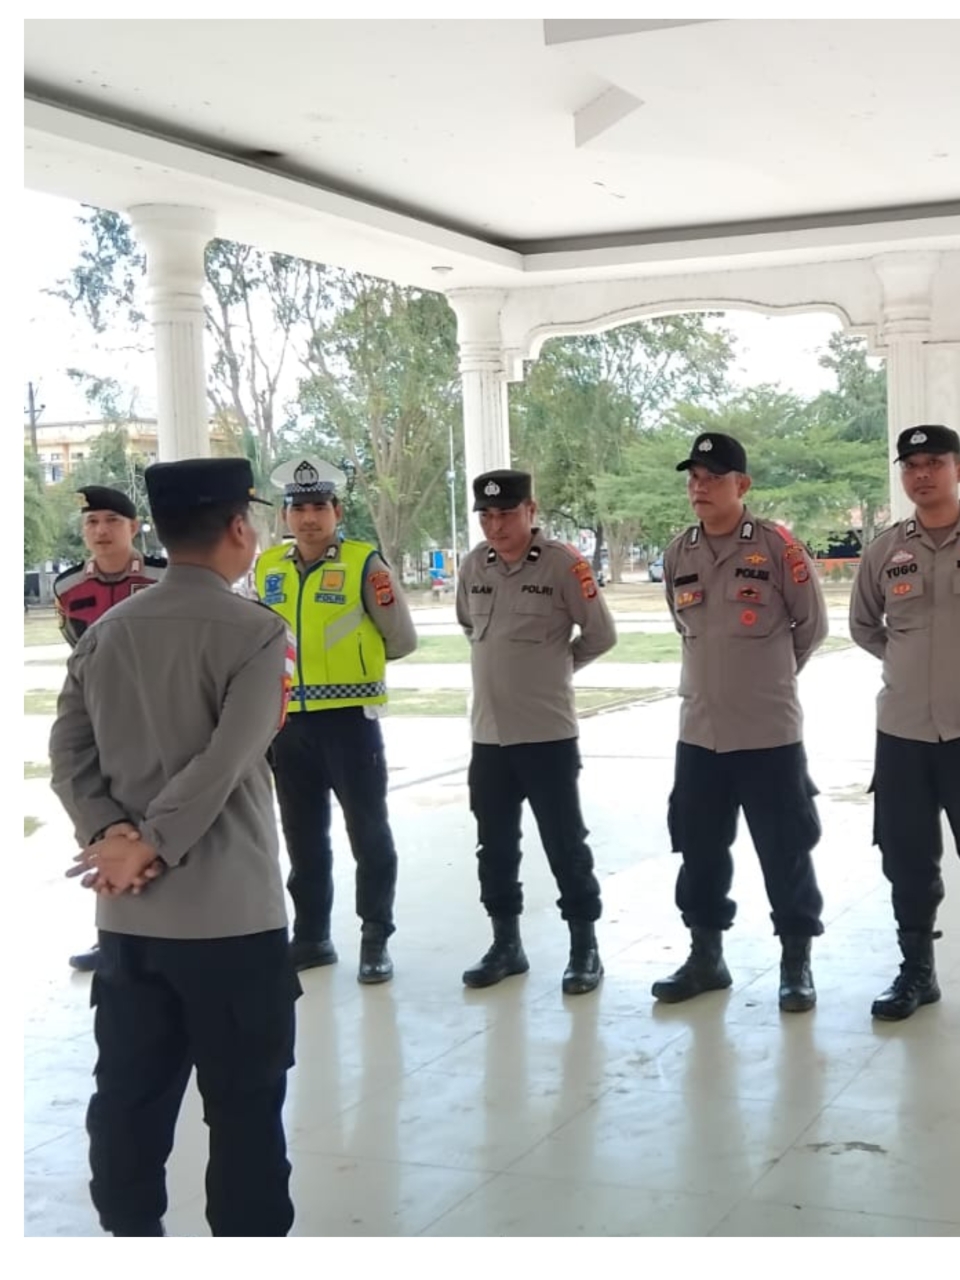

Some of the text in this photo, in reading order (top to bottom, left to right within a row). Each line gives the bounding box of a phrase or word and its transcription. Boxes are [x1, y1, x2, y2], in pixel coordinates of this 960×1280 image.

[735, 567, 770, 582] POLRI
[886, 563, 918, 579] YUGO
[520, 585, 554, 596] POLRI
[317, 594, 345, 604] POLRI
